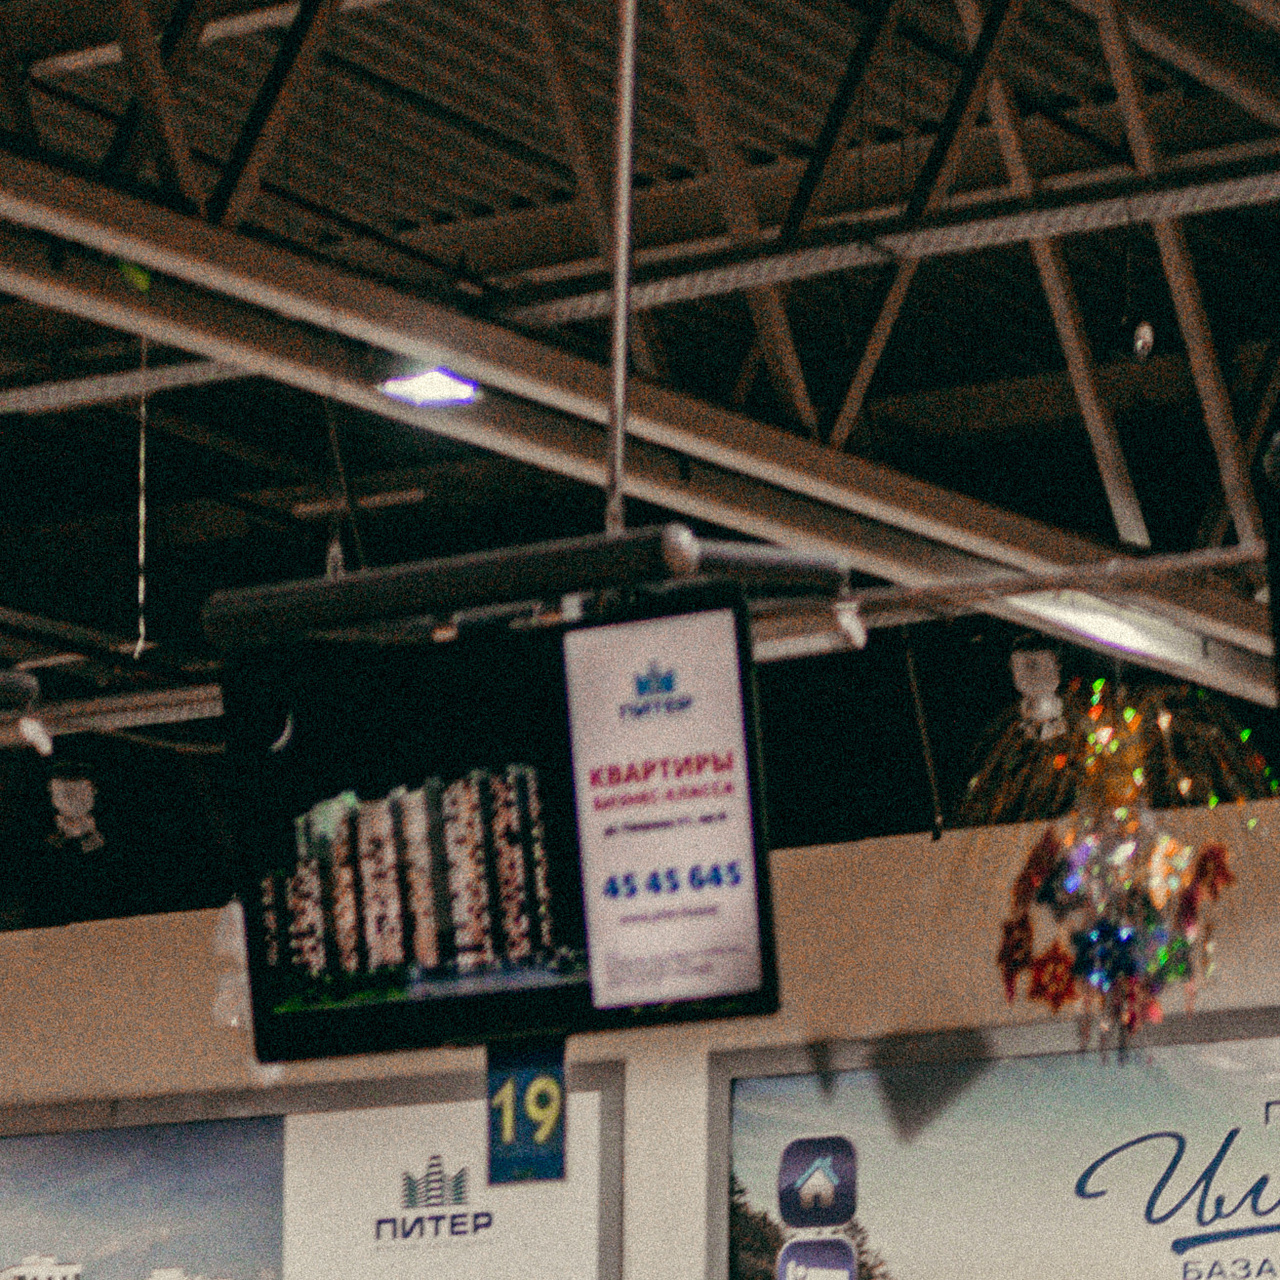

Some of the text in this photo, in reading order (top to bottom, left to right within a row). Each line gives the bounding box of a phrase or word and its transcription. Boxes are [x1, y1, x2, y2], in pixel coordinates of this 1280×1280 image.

[590, 751, 735, 789] КВАРТИРЫ
[603, 860, 742, 900] 45 45 645
[492, 1075, 563, 1145] 19
[375, 1211, 494, 1242] ПИТЕР
